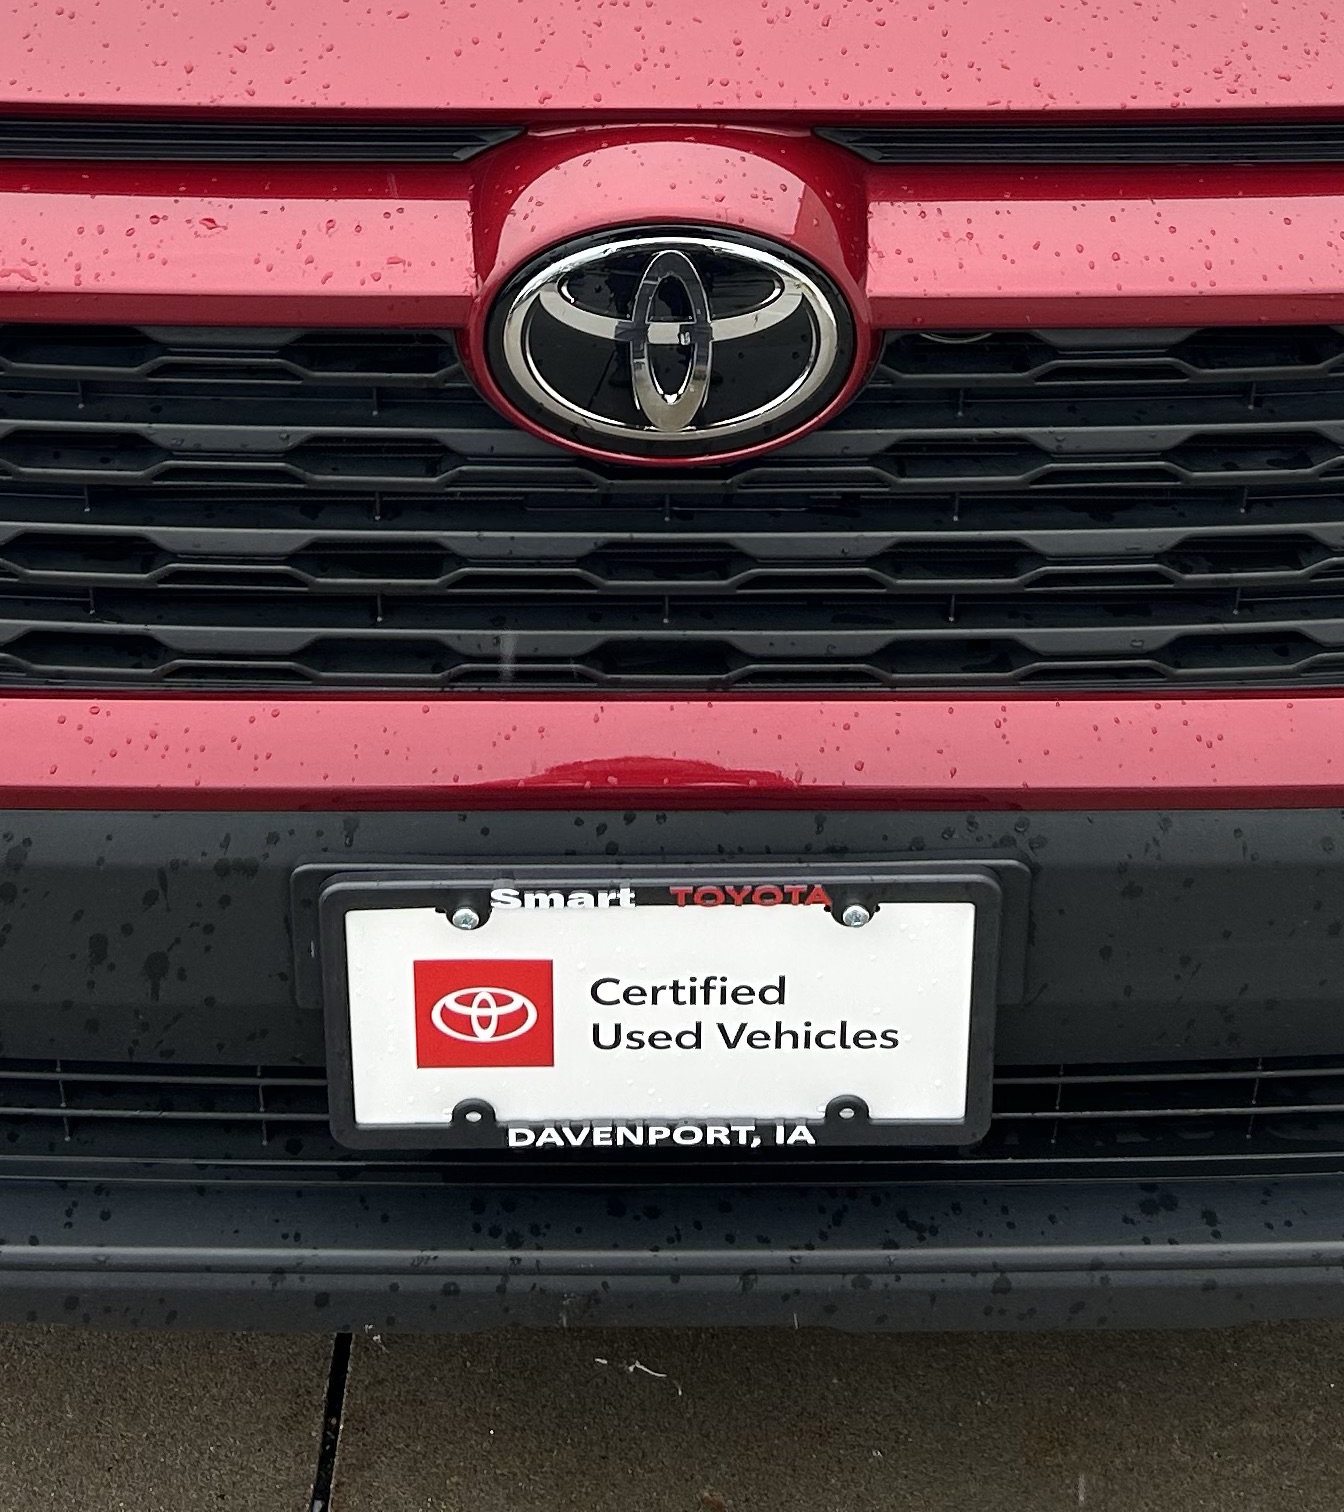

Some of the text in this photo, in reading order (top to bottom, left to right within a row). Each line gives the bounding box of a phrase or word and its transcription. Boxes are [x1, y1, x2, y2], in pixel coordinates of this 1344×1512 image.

[490, 884, 832, 909] Smart TOYOTA
[590, 975, 786, 1006] Certified
[592, 1020, 899, 1050] Used Vehicles
[507, 1125, 816, 1148] DAVENPORT, IA
